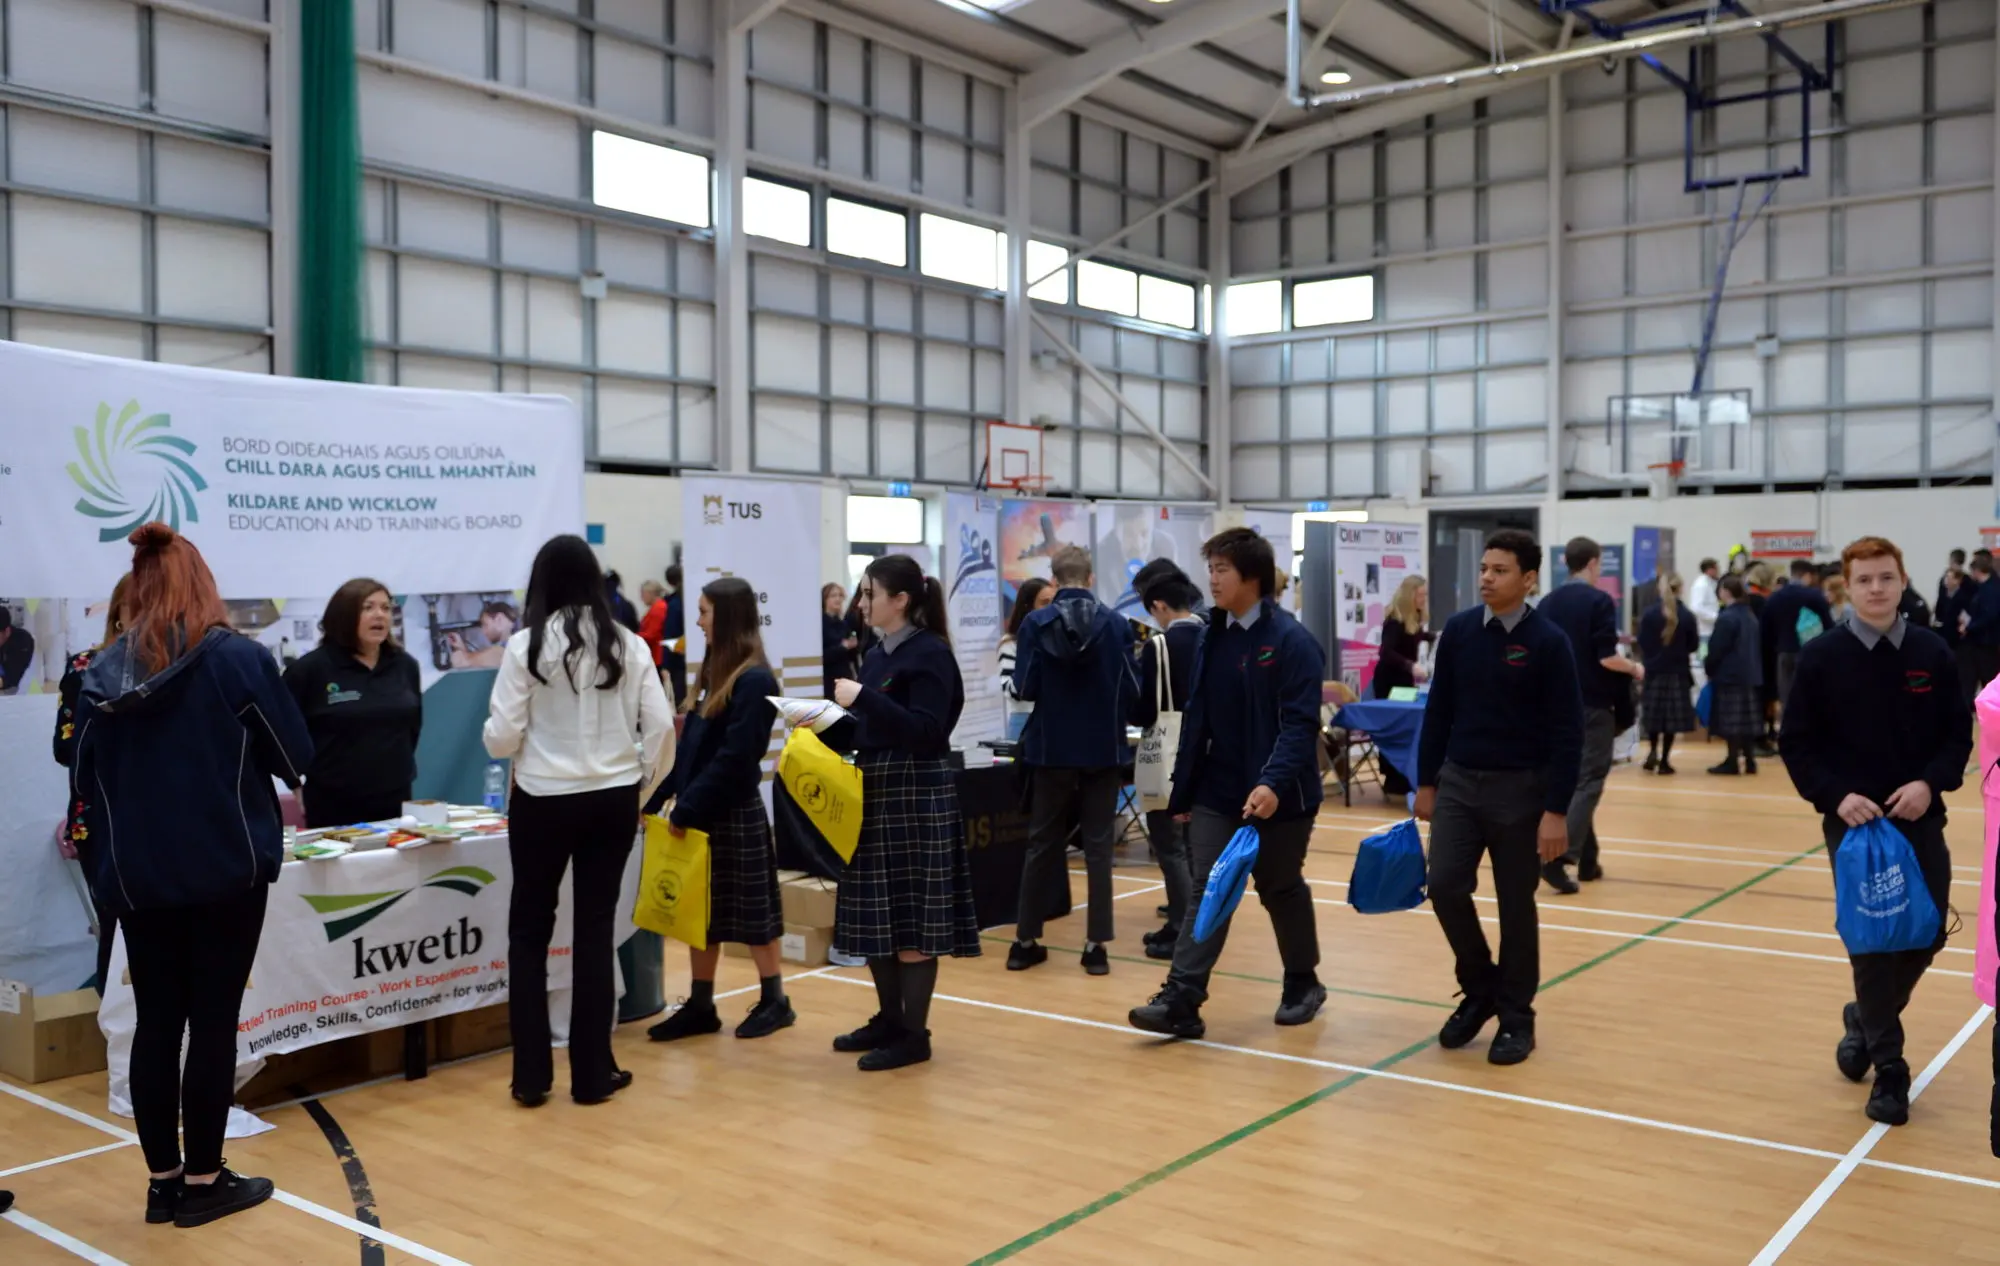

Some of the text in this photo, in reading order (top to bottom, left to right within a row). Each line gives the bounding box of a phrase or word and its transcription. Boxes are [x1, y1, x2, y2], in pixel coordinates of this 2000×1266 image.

[223, 437, 505, 460] BORD OIDEACHAIS AGUS OILIÚNA
[225, 458, 536, 479] CHILL DARA AGUS CHILL MHANTÁIN
[227, 494, 437, 511] KILDARE AND WICKLOW
[728, 502, 762, 519] TUS
[228, 514, 523, 531] EDUCATION AND TRAINING BOARD
[352, 916, 483, 979] kwetb
[266, 998, 317, 1023] Training
[321, 988, 369, 1007] Course
[378, 978, 411, 995] Work
[415, 964, 479, 988] Experience
[316, 1011, 362, 1029] Skills,
[365, 994, 442, 1020] Confidence
[453, 985, 471, 999] for
